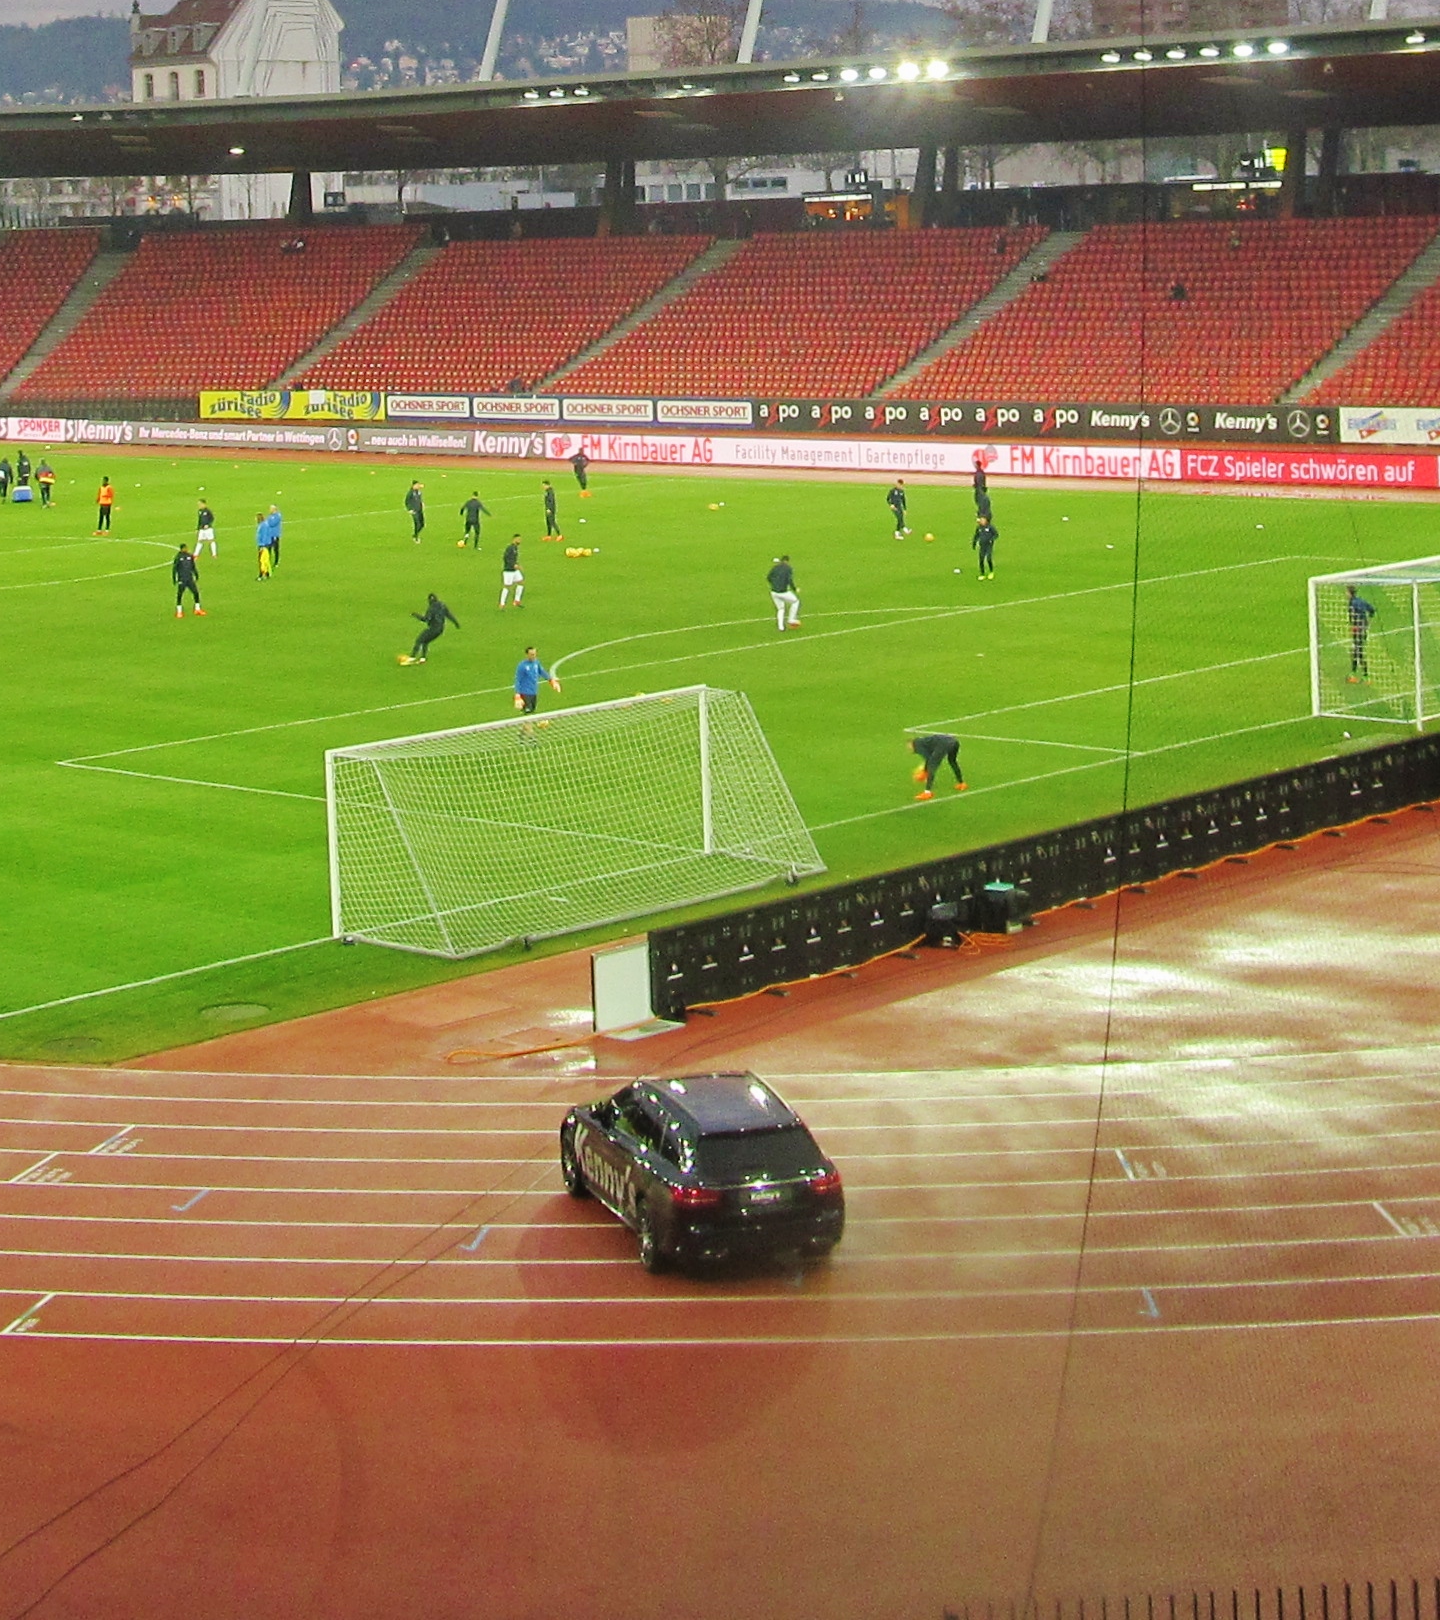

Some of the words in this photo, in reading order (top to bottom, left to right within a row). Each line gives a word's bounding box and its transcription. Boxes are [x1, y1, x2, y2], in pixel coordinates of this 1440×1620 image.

[241, 391, 275, 406] radio
[333, 391, 366, 406] radio
[390, 399, 433, 412] OCHSNER
[435, 400, 465, 412] SPORT
[477, 402, 521, 414] OCHSNER
[523, 403, 555, 414] SPORT
[566, 403, 613, 415] OCHSNER
[616, 404, 649, 415] SPORT
[661, 404, 710, 417] OCHSNER
[713, 406, 748, 417] SPORT
[17, 419, 61, 434] SPONSER
[1090, 410, 1151, 431] Kenny's
[1214, 412, 1278, 432] Kenny's
[77, 420, 132, 443] Kenny's
[388, 434, 407, 447] auch
[409, 434, 417, 447] in
[474, 430, 543, 458] Kenny's
[609, 434, 686, 462] Kirnbauer
[691, 437, 713, 462] AG
[735, 445, 777, 463] Facility
[781, 445, 853, 466] Management
[866, 447, 946, 468] Gartenpflege
[1010, 446, 1034, 472] FM
[1043, 446, 1142, 476] Kirnbauer
[1148, 451, 1175, 477] AG
[1187, 454, 1219, 478] FCZ
[1224, 455, 1286, 481] Spieler
[1290, 458, 1379, 482] schwören
[1384, 460, 1415, 482] auf
